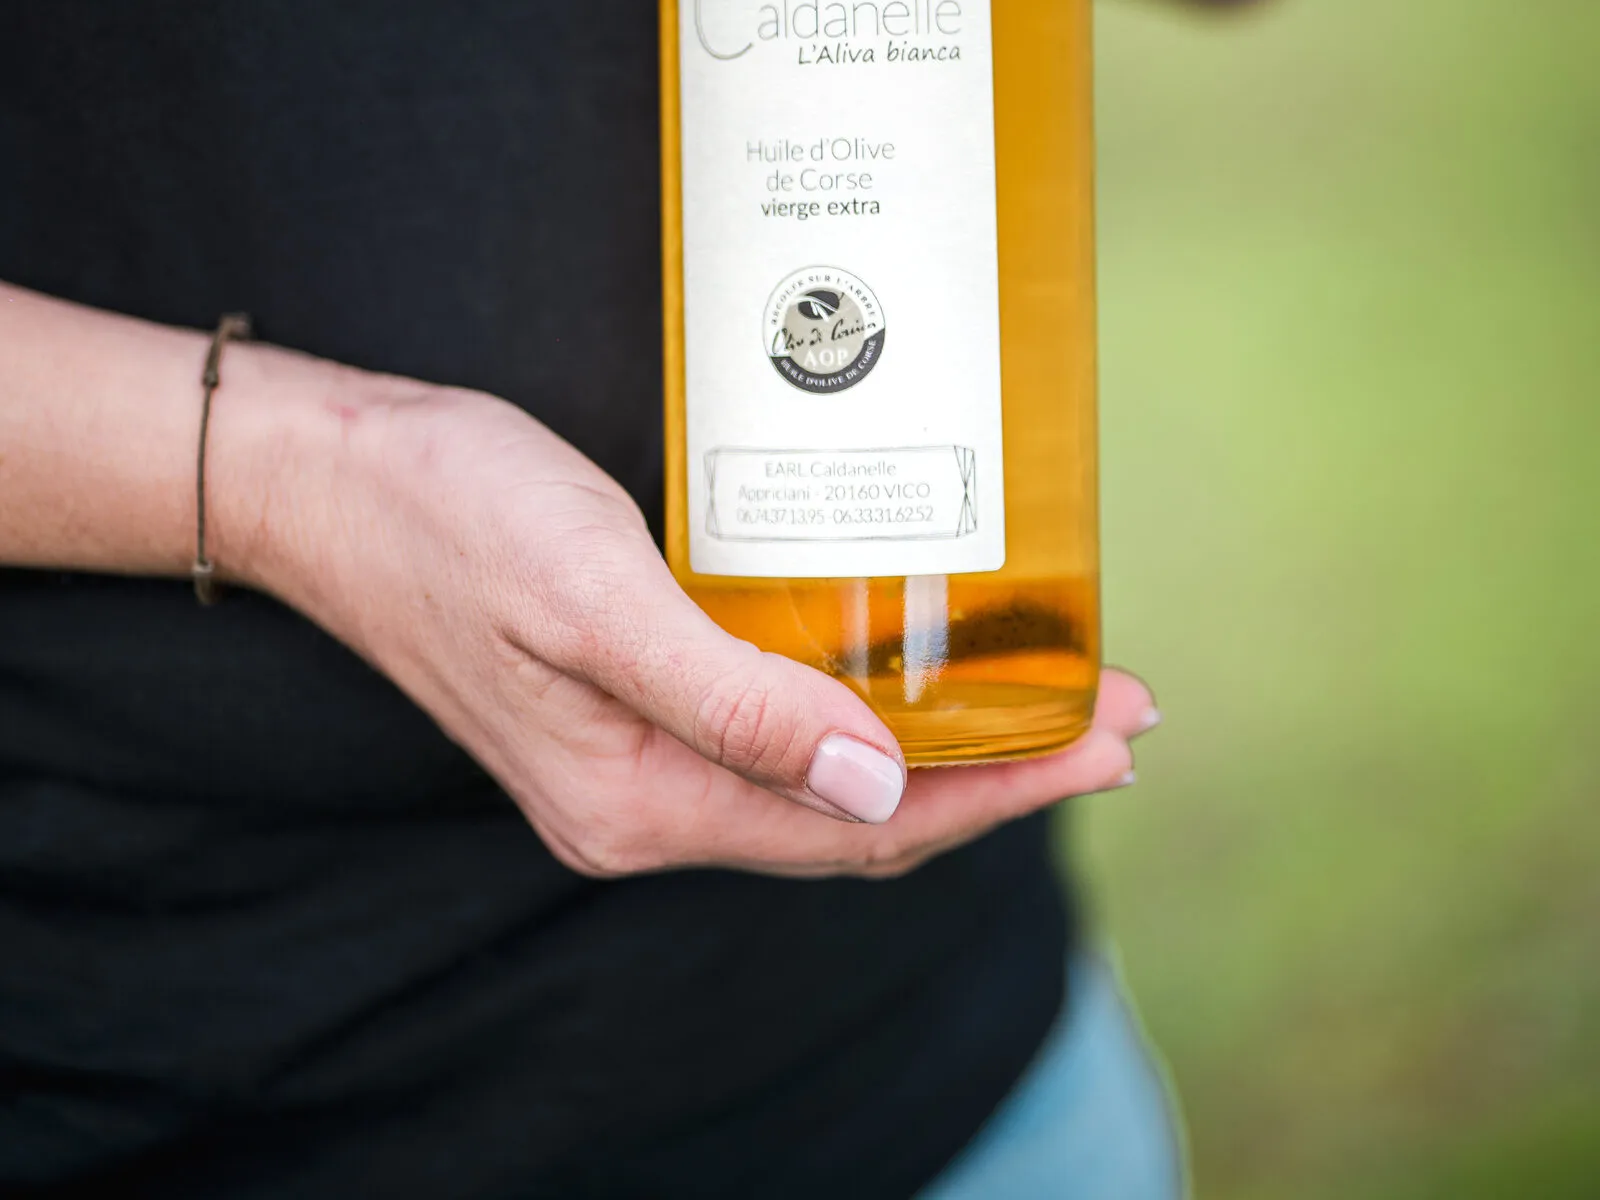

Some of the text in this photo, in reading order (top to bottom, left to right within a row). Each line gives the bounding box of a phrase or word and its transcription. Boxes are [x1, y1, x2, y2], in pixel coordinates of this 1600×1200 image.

[798, 41, 961, 65] L'Aliva bianca
[746, 137, 895, 162] Huile d'Olive
[766, 168, 873, 192] de Corse
[760, 197, 880, 220] vierge extra
[804, 348, 849, 367] AOP
[765, 460, 897, 478] EARL Caldanelle
[825, 484, 880, 500] 20160
[883, 482, 930, 499] VICO
